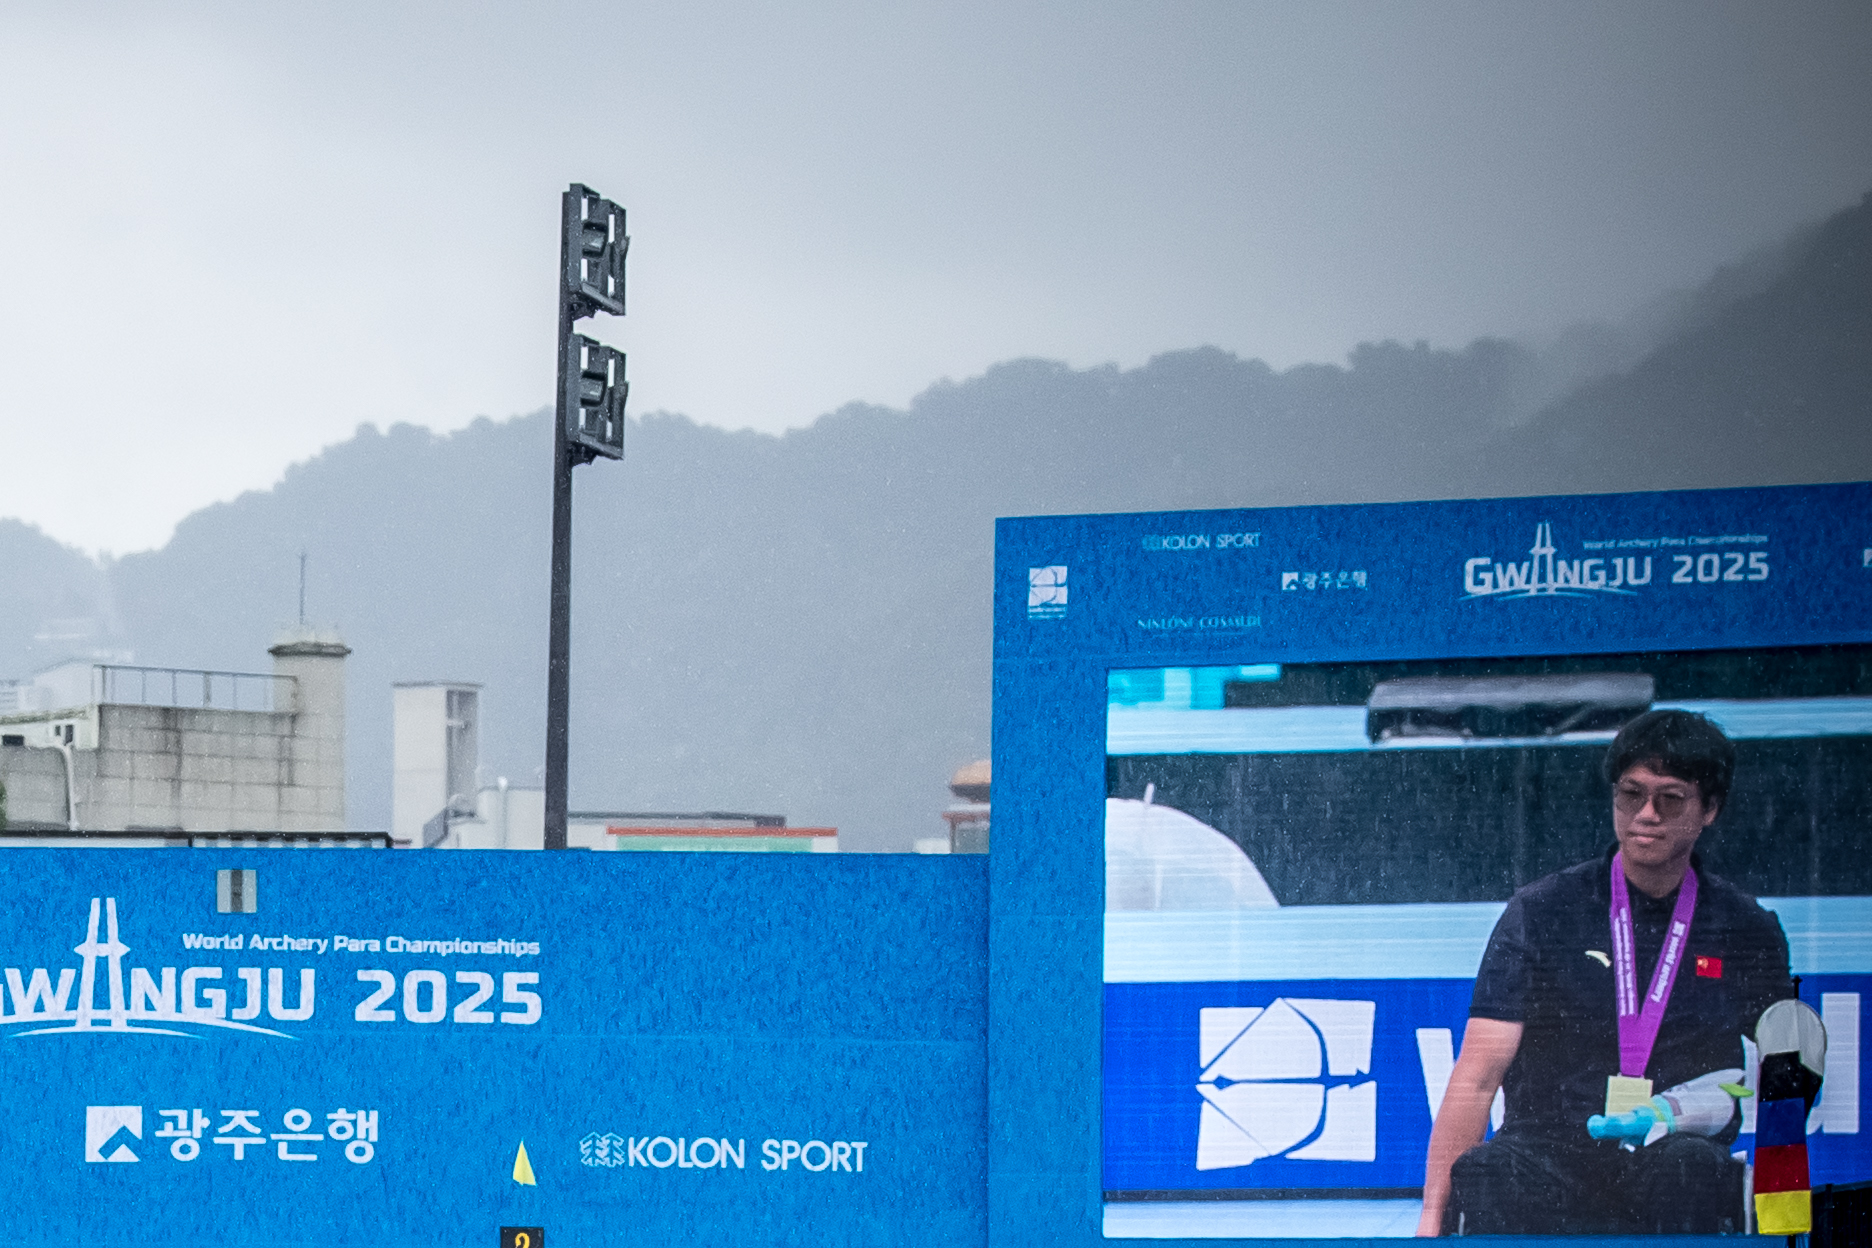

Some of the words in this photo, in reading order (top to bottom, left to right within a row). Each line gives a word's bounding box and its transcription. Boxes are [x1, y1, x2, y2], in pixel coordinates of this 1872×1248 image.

[1162, 534, 1210, 549] KOLON
[1216, 532, 1261, 548] SPORT
[1465, 522, 1652, 595] GWANGJU
[1671, 551, 1770, 584] 2025
[183, 933, 243, 950] World
[249, 934, 329, 954] Archery
[334, 935, 381, 951] Para
[385, 936, 540, 957] Championships
[354, 970, 543, 1024] 2025
[155, 1107, 379, 1163] 광주은행
[628, 1135, 745, 1168] KOLON
[761, 1138, 869, 1172] SPORT
